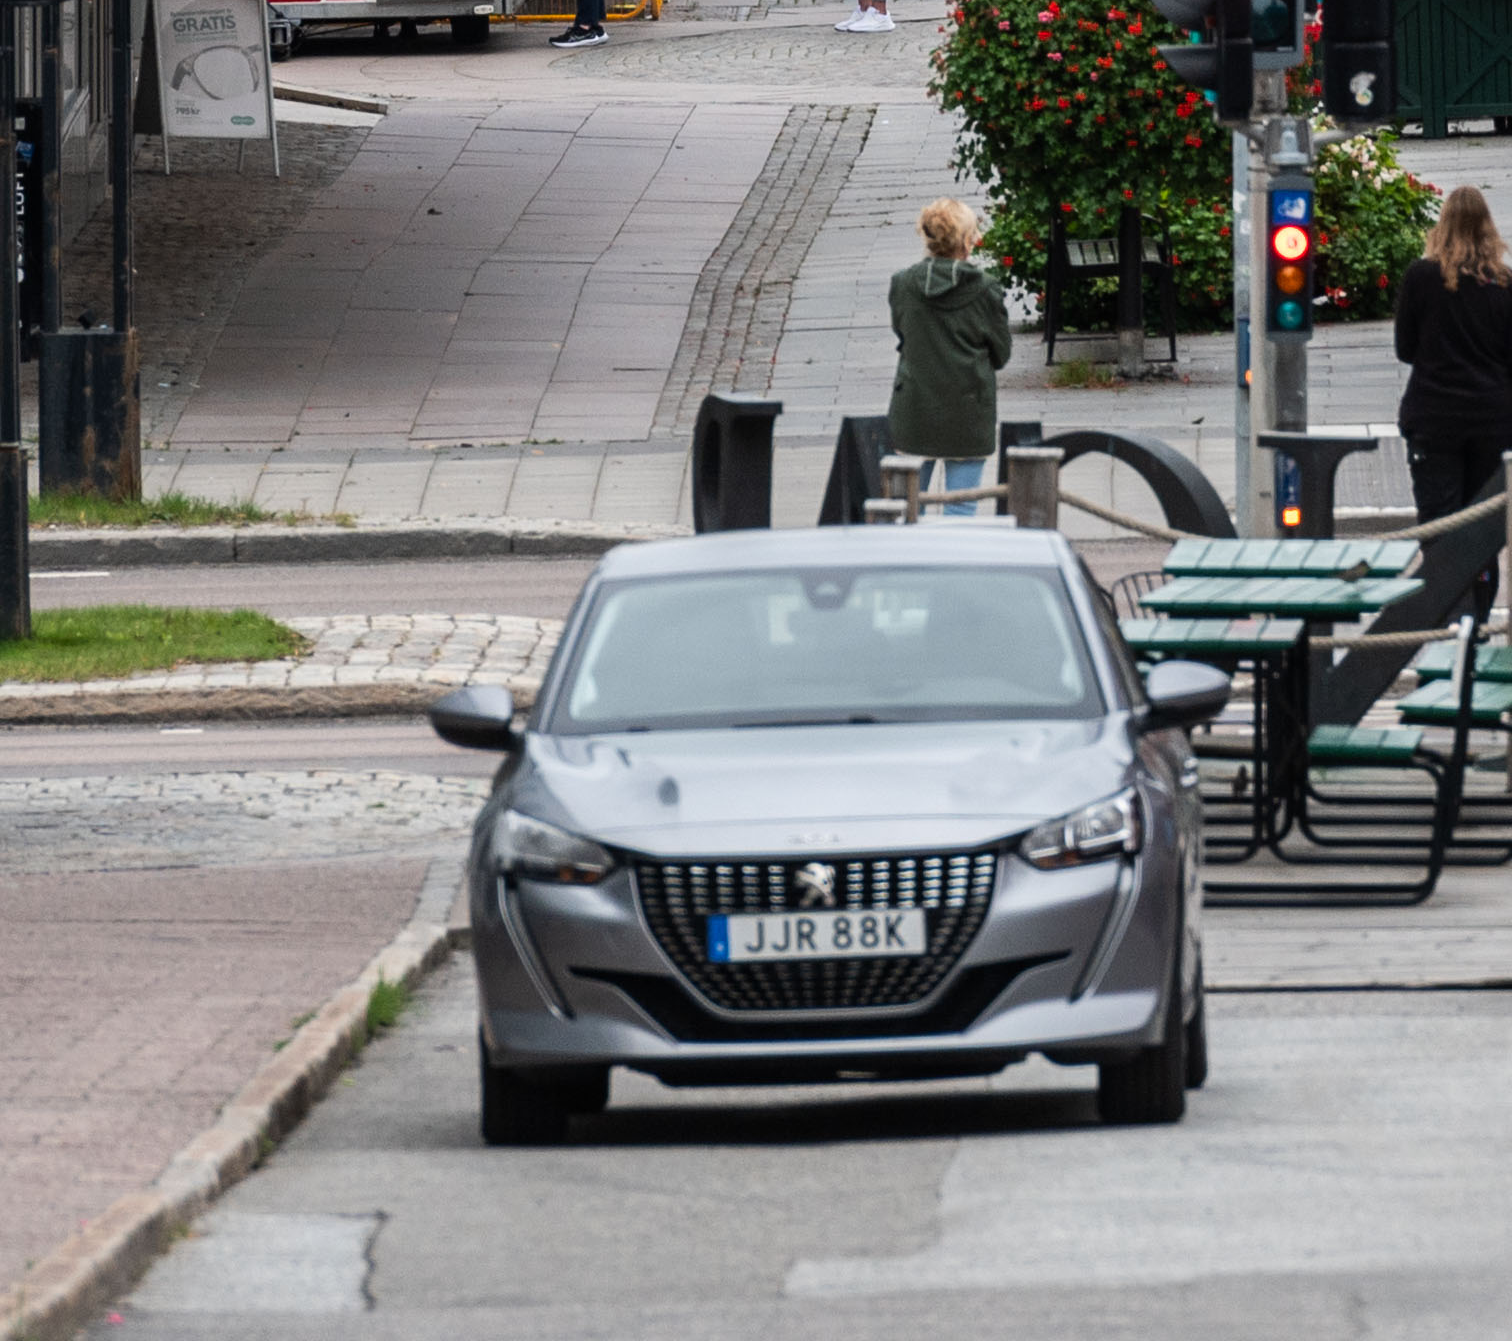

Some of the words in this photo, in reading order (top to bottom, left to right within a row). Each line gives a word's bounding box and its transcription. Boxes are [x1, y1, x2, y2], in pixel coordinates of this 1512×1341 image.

[172, 16, 237, 33] GRATIS
[744, 917, 816, 954] JJR
[830, 911, 909, 951] 88K
